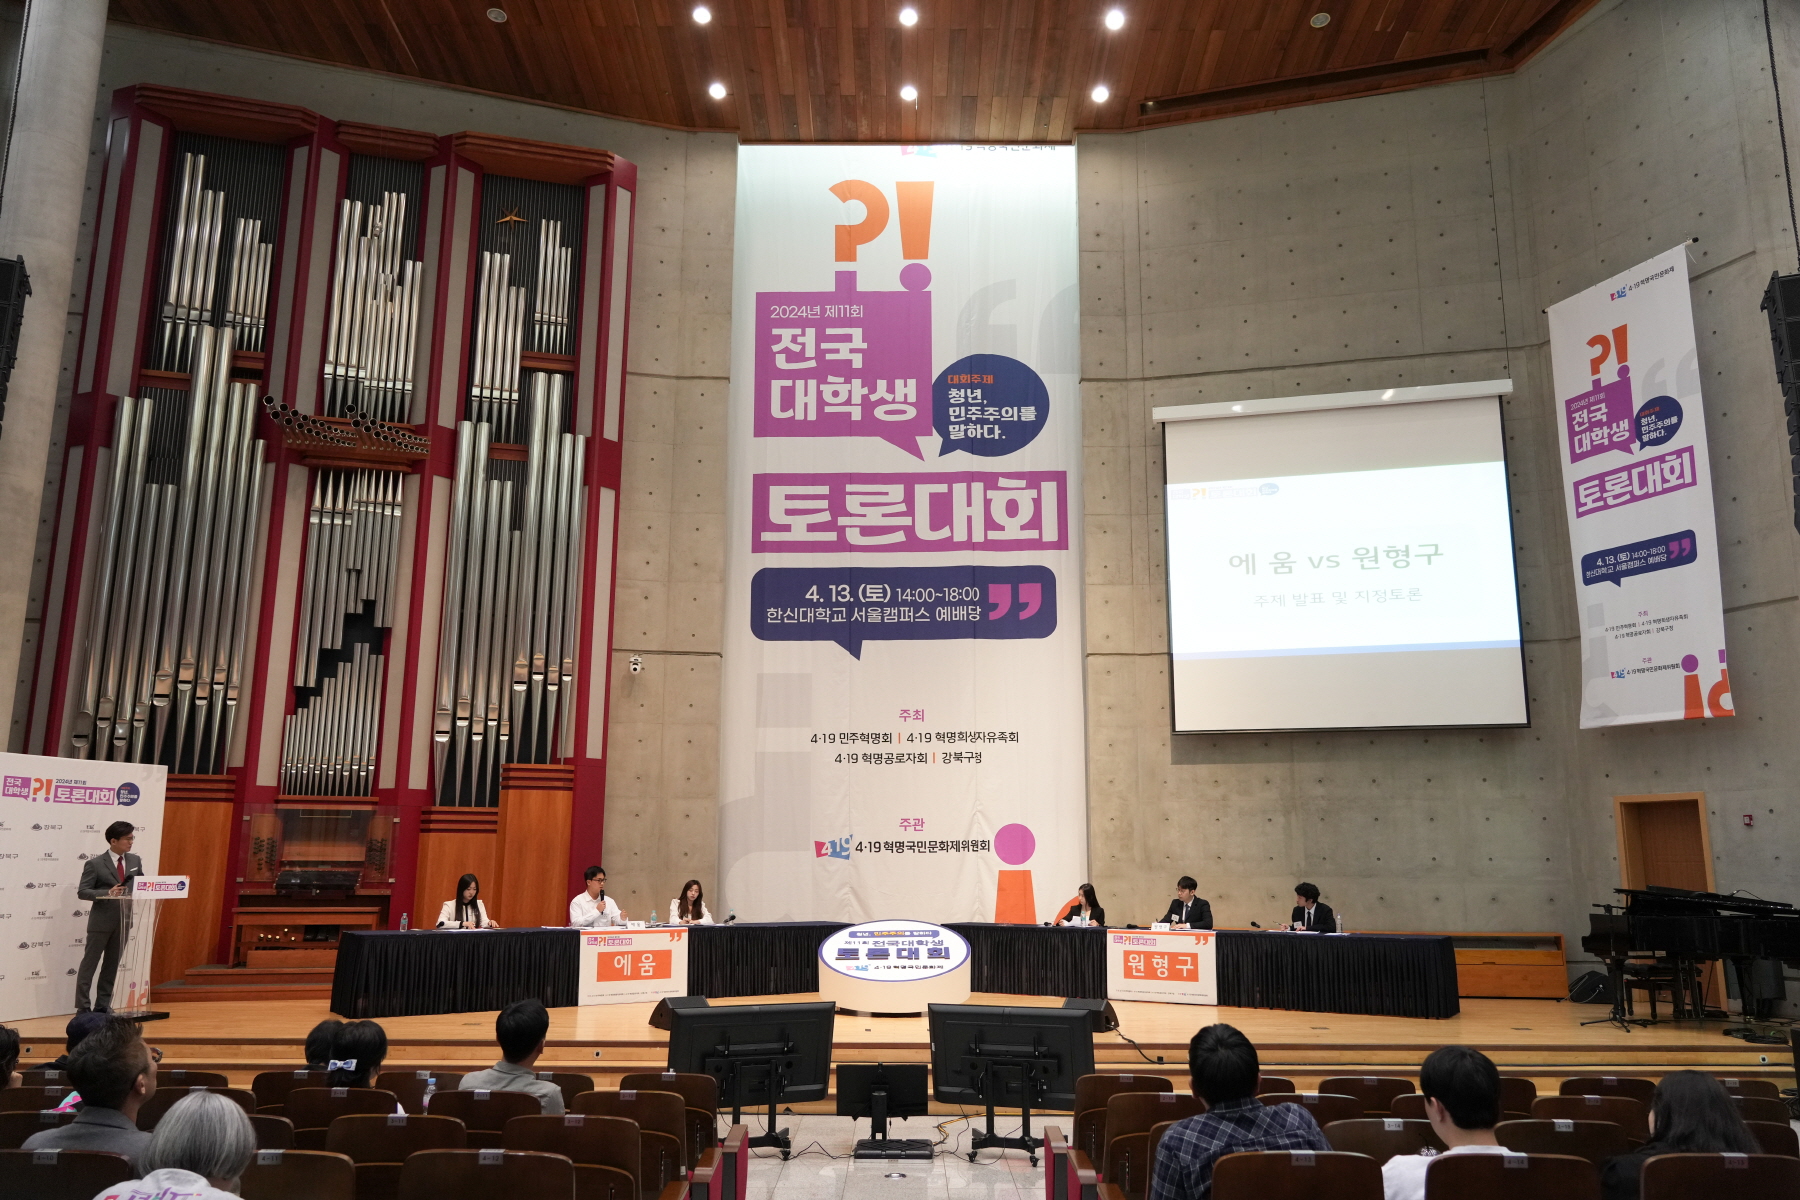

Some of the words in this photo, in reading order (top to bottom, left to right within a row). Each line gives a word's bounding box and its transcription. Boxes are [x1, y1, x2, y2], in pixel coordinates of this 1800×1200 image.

[770, 304, 821, 319] 2024년
[824, 304, 864, 318] 제11회
[770, 327, 868, 370] 전국
[947, 373, 994, 385] 대회주제
[770, 375, 918, 422] 대학생
[948, 387, 988, 405] 청년,
[1570, 398, 1589, 411] 2024년
[1589, 391, 1605, 403] 제11회
[948, 406, 1038, 422] 민주주의를
[1572, 402, 1608, 432] 전국
[948, 424, 1006, 440] 말하다.
[1641, 415, 1679, 433] 민주주의를
[1574, 418, 1630, 454] 대학생
[1642, 428, 1667, 442] 말하다.
[1578, 451, 1693, 513] 토론대회
[760, 476, 1059, 546] 토론대회
[1351, 543, 1444, 571] 원형구
[1586, 565, 1614, 579] 한신대학교
[1647, 553, 1668, 565] 예배당
[804, 585, 824, 603] 4.
[828, 585, 854, 602] 13.
[858, 583, 891, 603] (토)
[895, 587, 980, 603] 14:00~18:00
[1253, 594, 1286, 609] 주제
[1292, 592, 1326, 607] 발표
[1331, 590, 1348, 605] 및
[1353, 587, 1424, 605] 지정토론
[766, 606, 847, 623] 한신대학교
[850, 606, 931, 623] 서울캠퍼스
[936, 604, 982, 622] 예배당
[898, 708, 925, 723] 주최
[839, 731, 893, 744] 민주혁명회
[861, 752, 928, 765] 혁명공로자회
[4, 786, 29, 796] 대학생
[6, 777, 22, 787] 전국
[55, 787, 114, 805] 토론대회
[898, 817, 925, 832] 주관
[835, 946, 951, 961] 토론대회
